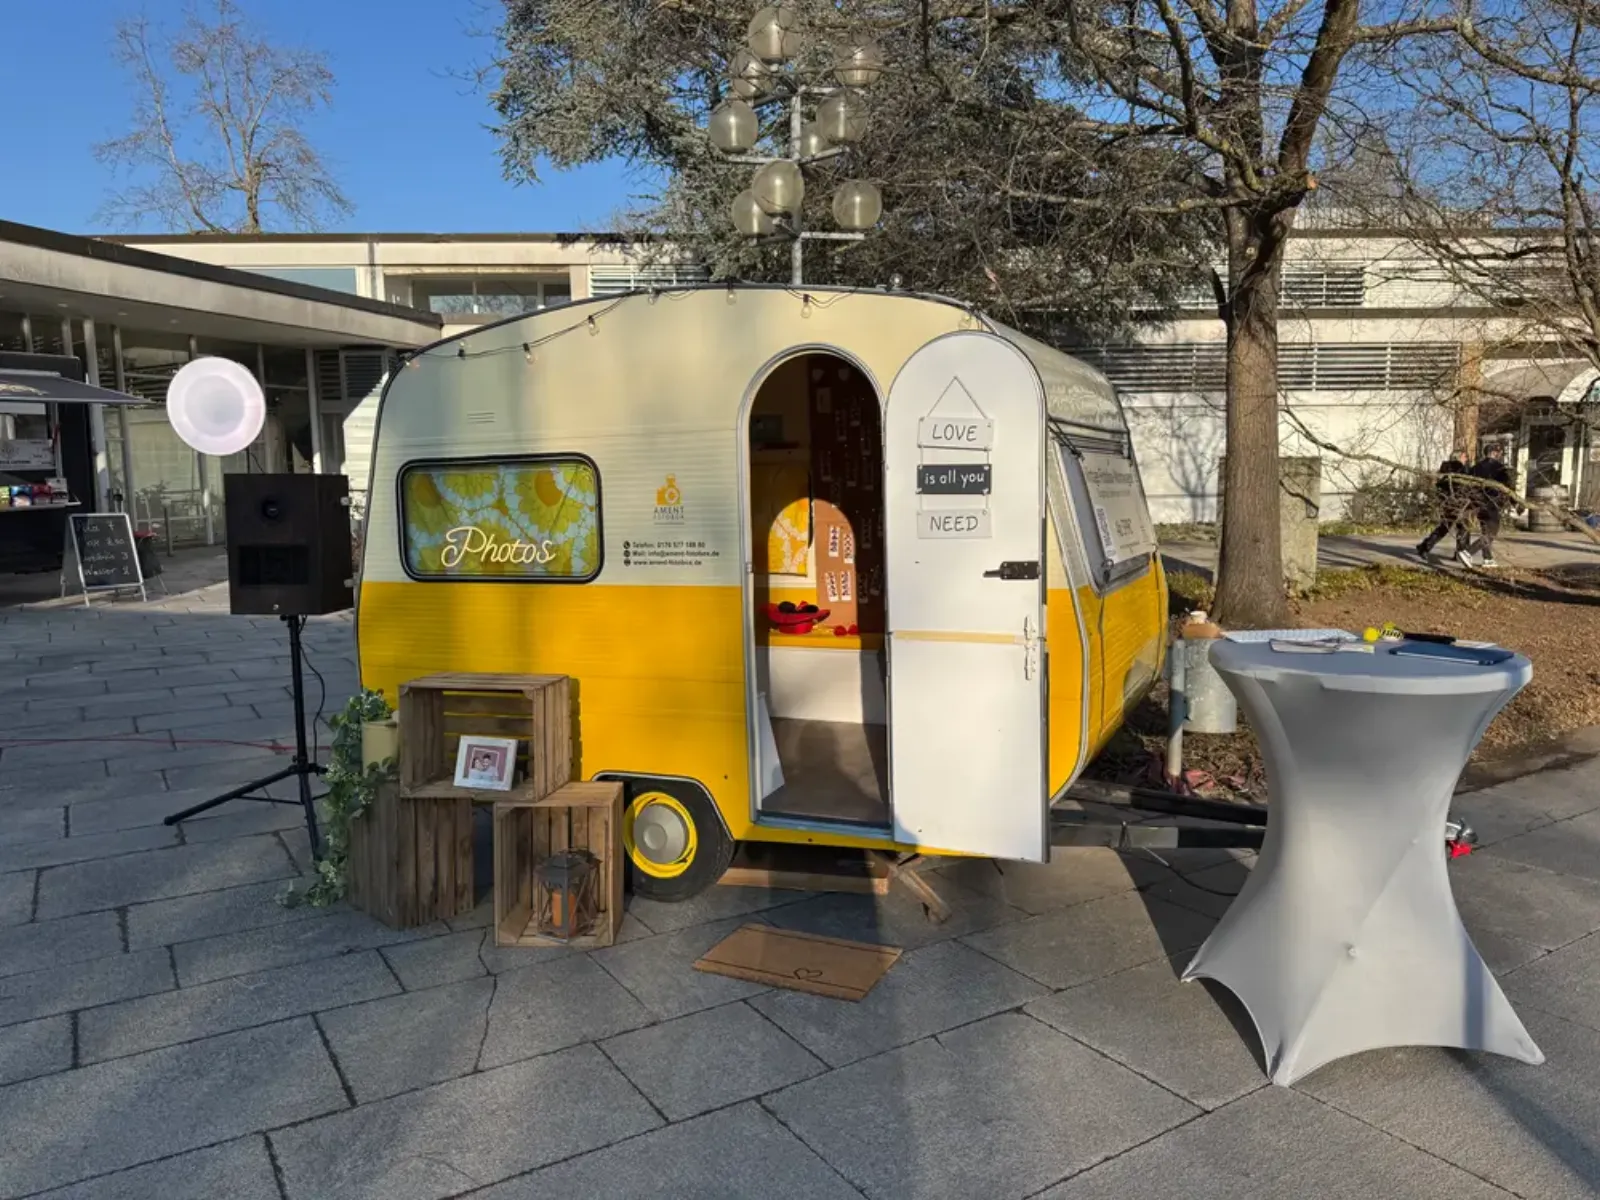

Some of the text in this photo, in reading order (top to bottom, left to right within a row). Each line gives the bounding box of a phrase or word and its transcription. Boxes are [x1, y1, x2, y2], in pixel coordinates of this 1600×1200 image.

[931, 423, 978, 442] LOVE
[924, 468, 985, 489] is all you
[653, 506, 685, 514] AMENT
[929, 515, 979, 532] NEED
[441, 526, 557, 567] Photos
